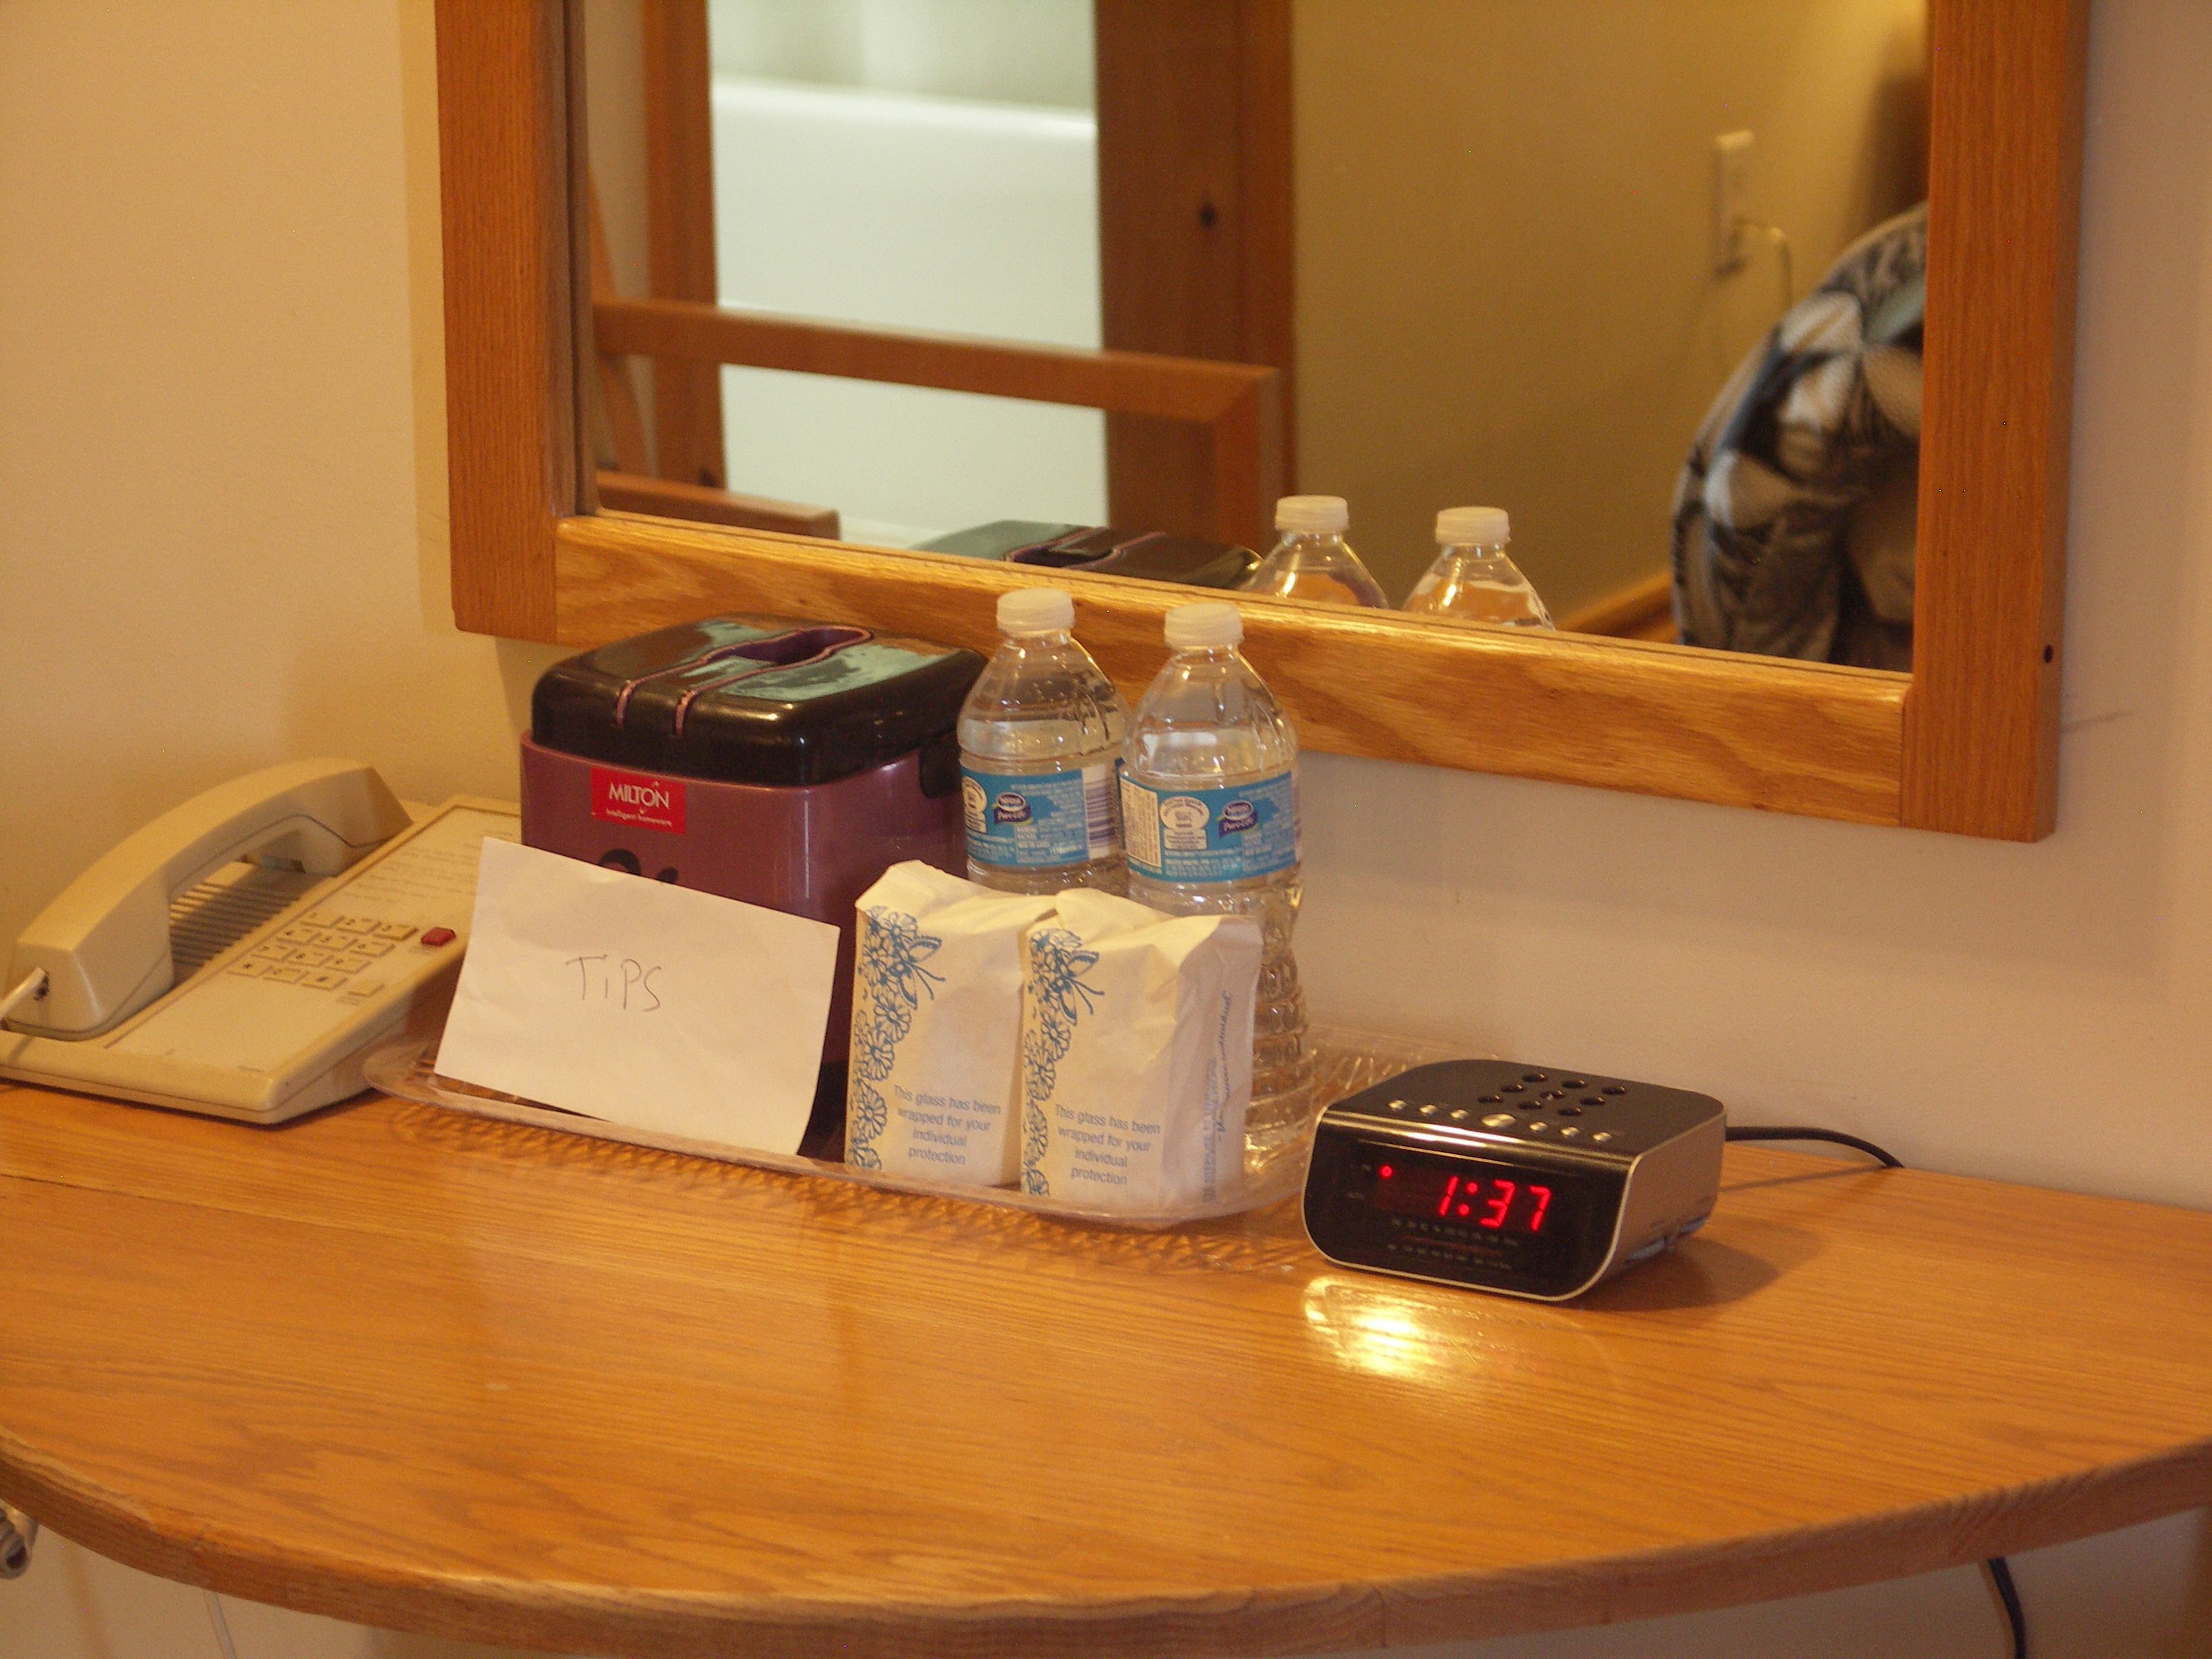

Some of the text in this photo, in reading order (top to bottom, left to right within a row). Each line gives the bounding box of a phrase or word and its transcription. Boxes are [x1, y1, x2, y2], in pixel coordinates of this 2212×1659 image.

[609, 782, 670, 809] MILTON
[895, 1084, 1002, 1115] This glass has been
[898, 1107, 991, 1132] wrapped for your
[1055, 1103, 1161, 1135] This glass has been
[912, 1129, 967, 1147] individual
[1058, 1127, 1151, 1153] wrapped for your
[908, 1147, 966, 1166] protection
[1074, 1149, 1128, 1168] individual
[1070, 1167, 1128, 1186] protection
[1437, 1175, 1554, 1232] 1:37
